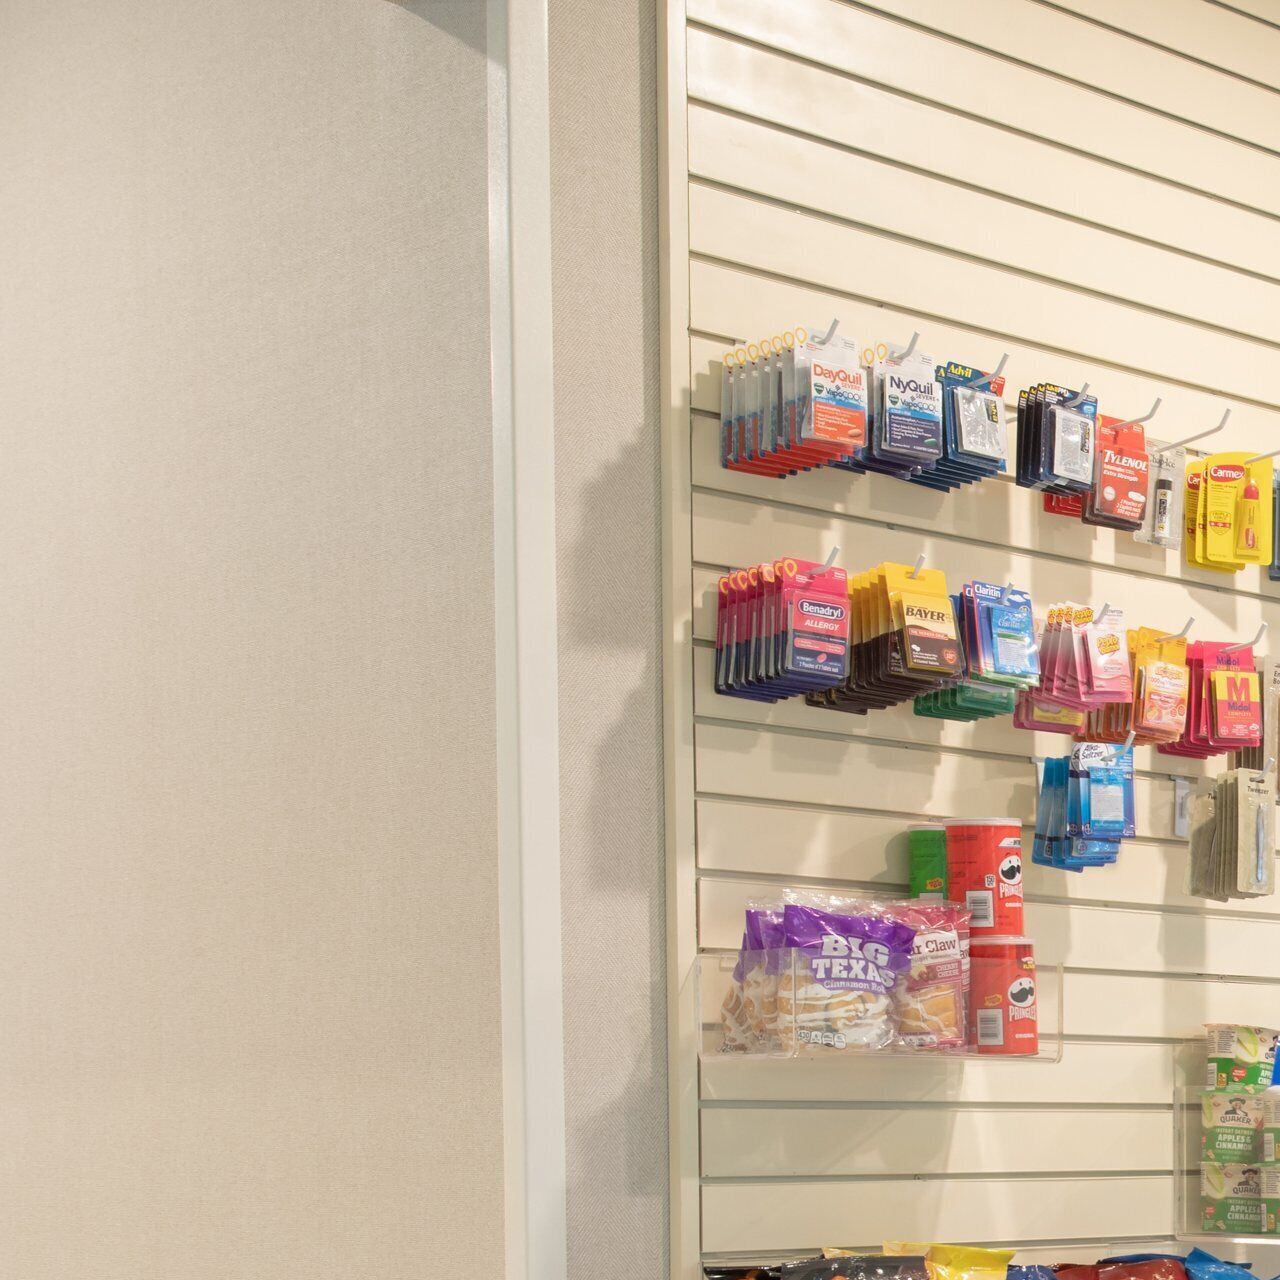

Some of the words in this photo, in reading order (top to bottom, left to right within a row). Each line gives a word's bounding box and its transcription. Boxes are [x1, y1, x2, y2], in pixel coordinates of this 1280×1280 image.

[813, 364, 861, 386] DayQuil
[950, 364, 972, 378] Advil
[889, 376, 933, 396] NyQuil
[1104, 449, 1148, 471] TYLENOL
[1210, 466, 1244, 479] Carmex
[975, 584, 1000, 598] Claritin
[803, 602, 841, 618] Benadryl
[906, 607, 944, 622] BAYER
[804, 619, 840, 631] ALLERGY
[1226, 676, 1250, 702] M
[1228, 702, 1250, 712] Midol
[1247, 786, 1270, 796] Tweezer
[1000, 882, 1023, 898] PRINGLE
[822, 935, 890, 967] BIG
[926, 938, 957, 955] Claw
[812, 958, 897, 988] TEXAS
[823, 980, 870, 991] Cinnamon
[1220, 1116, 1252, 1126] QUAKER
[1218, 1134, 1244, 1142] APPLES
